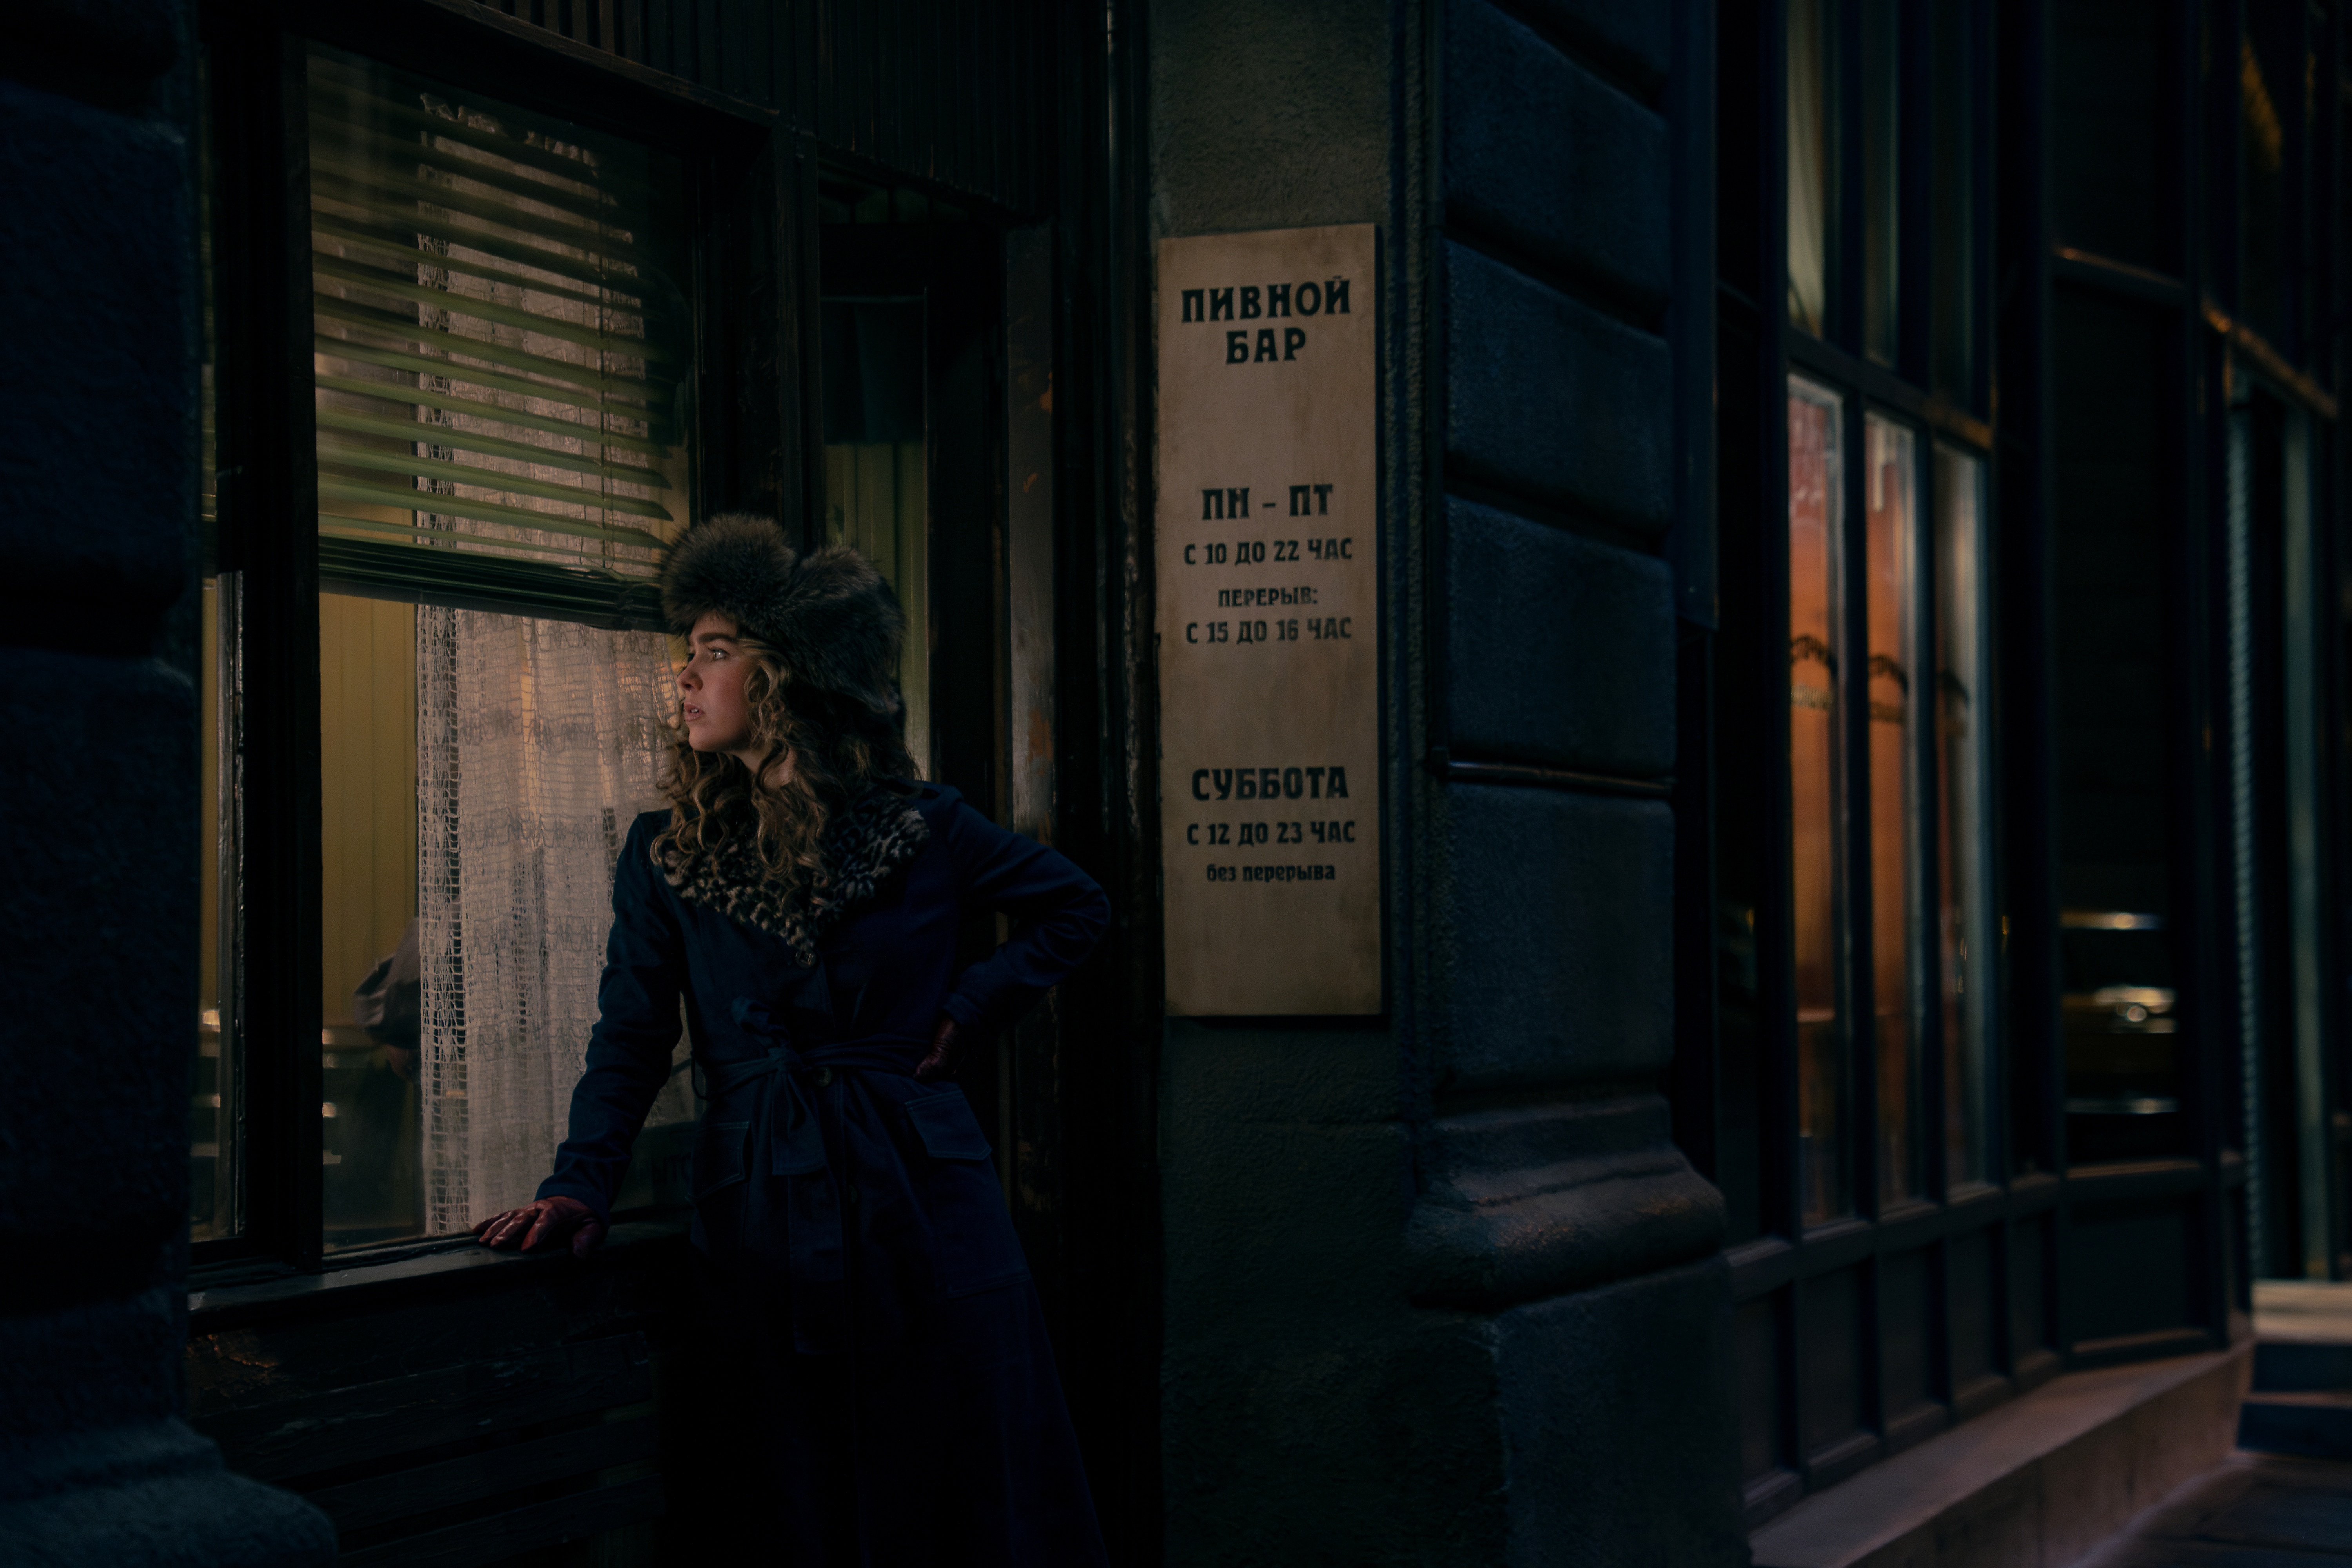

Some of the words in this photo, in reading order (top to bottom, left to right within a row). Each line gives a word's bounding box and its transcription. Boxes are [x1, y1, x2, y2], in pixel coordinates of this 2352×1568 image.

[1181, 276, 1351, 323] ПИВНОЙ
[1226, 327, 1307, 365] БАР
[1202, 487, 1250, 521] ПН
[1289, 483, 1333, 517] ПТ
[1184, 544, 1196, 565] С
[1205, 543, 1227, 564] 10
[1234, 541, 1266, 566] ДО
[1274, 540, 1300, 562] 22
[1308, 537, 1352, 560] ЧАС
[1218, 586, 1318, 607] ПЕРЕРЫВ:
[1186, 622, 1198, 644] С
[1206, 621, 1229, 644] 15
[1236, 620, 1267, 645] ДО
[1276, 618, 1299, 642] 16
[1307, 616, 1352, 640] ЧАС
[1192, 766, 1349, 802] СУББОТА
[1187, 823, 1199, 846] С
[1207, 823, 1230, 845] 12
[1238, 822, 1269, 847] ДО
[1276, 822, 1303, 844] 23
[1310, 820, 1356, 844] ЧАС
[1207, 864, 1237, 882] без
[1242, 864, 1336, 883] перерыва
